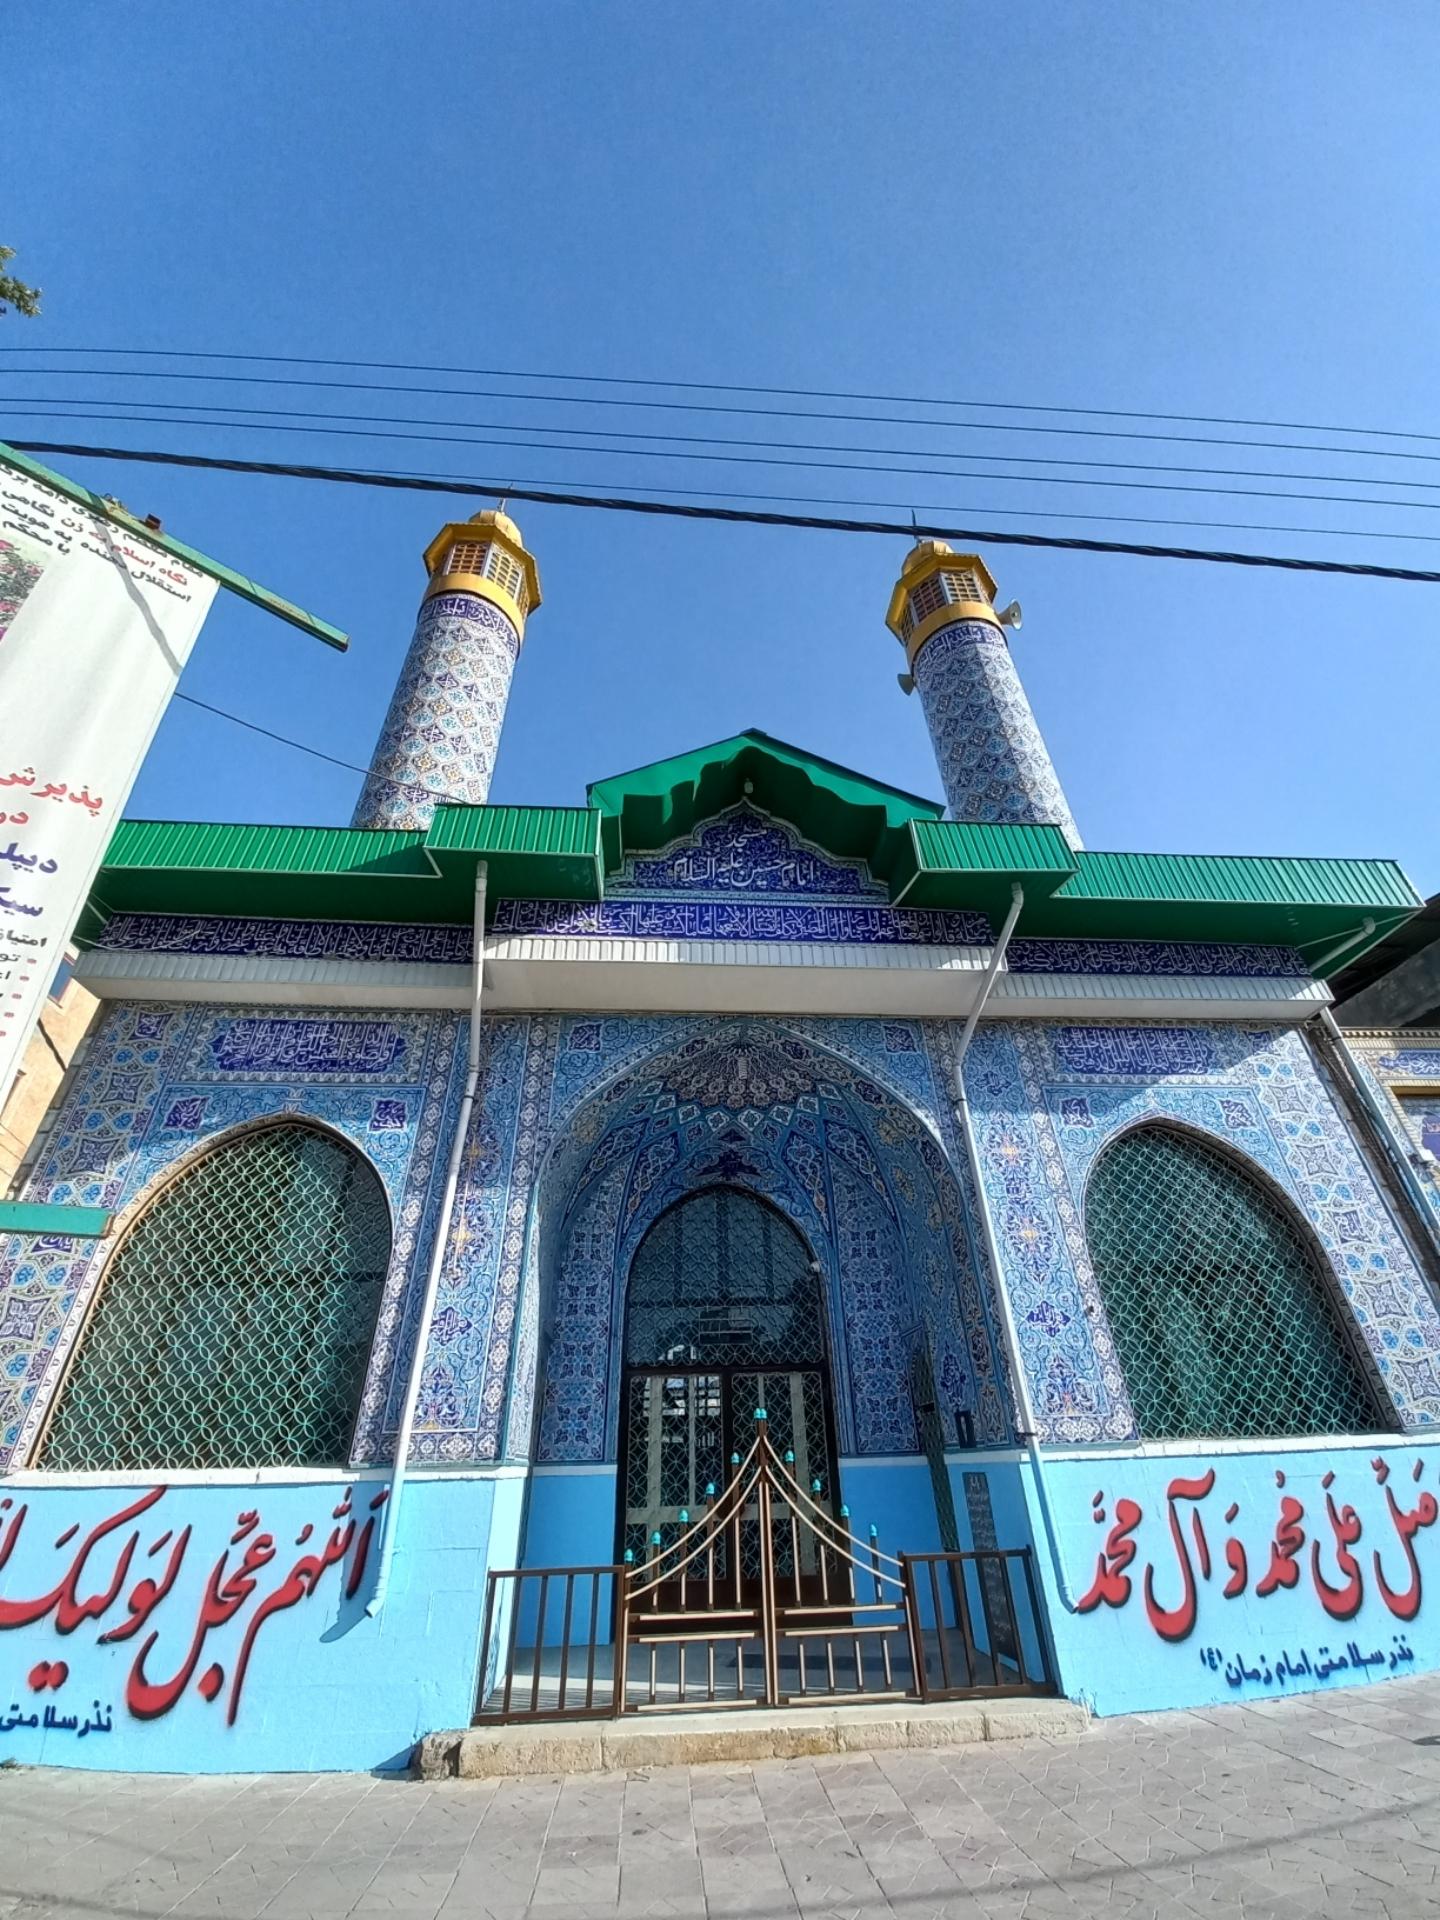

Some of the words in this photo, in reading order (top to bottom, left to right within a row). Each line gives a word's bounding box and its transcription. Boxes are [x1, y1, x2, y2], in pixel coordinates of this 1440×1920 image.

[1, 491, 55, 518] نگاهی
[1, 504, 50, 530] هویت
[3, 521, 53, 546] محکم
[54, 530, 73, 543] به
[61, 518, 84, 532] زن
[88, 531, 107, 544] به
[58, 543, 71, 556] با
[80, 542, 127, 569] دهنده
[111, 545, 156, 568] اسلام
[131, 571, 192, 602] استقلال
[159, 568, 188, 586] نگاه
[725, 828, 767, 852] مسجد
[781, 860, 814, 887] امام
[1256, 1470, 1305, 1597] محمد
[1077, 1490, 1142, 1614] محمد
[1144, 1468, 1215, 1643] آل
[126, 1509, 277, 1722] عجل
[1315, 1641, 1386, 1681] سلامتی
[1389, 1635, 1414, 1670] نذر
[1225, 1654, 1273, 1688] زمان
[1276, 1648, 1312, 1686] امام
[77, 1700, 112, 1738] نذر
